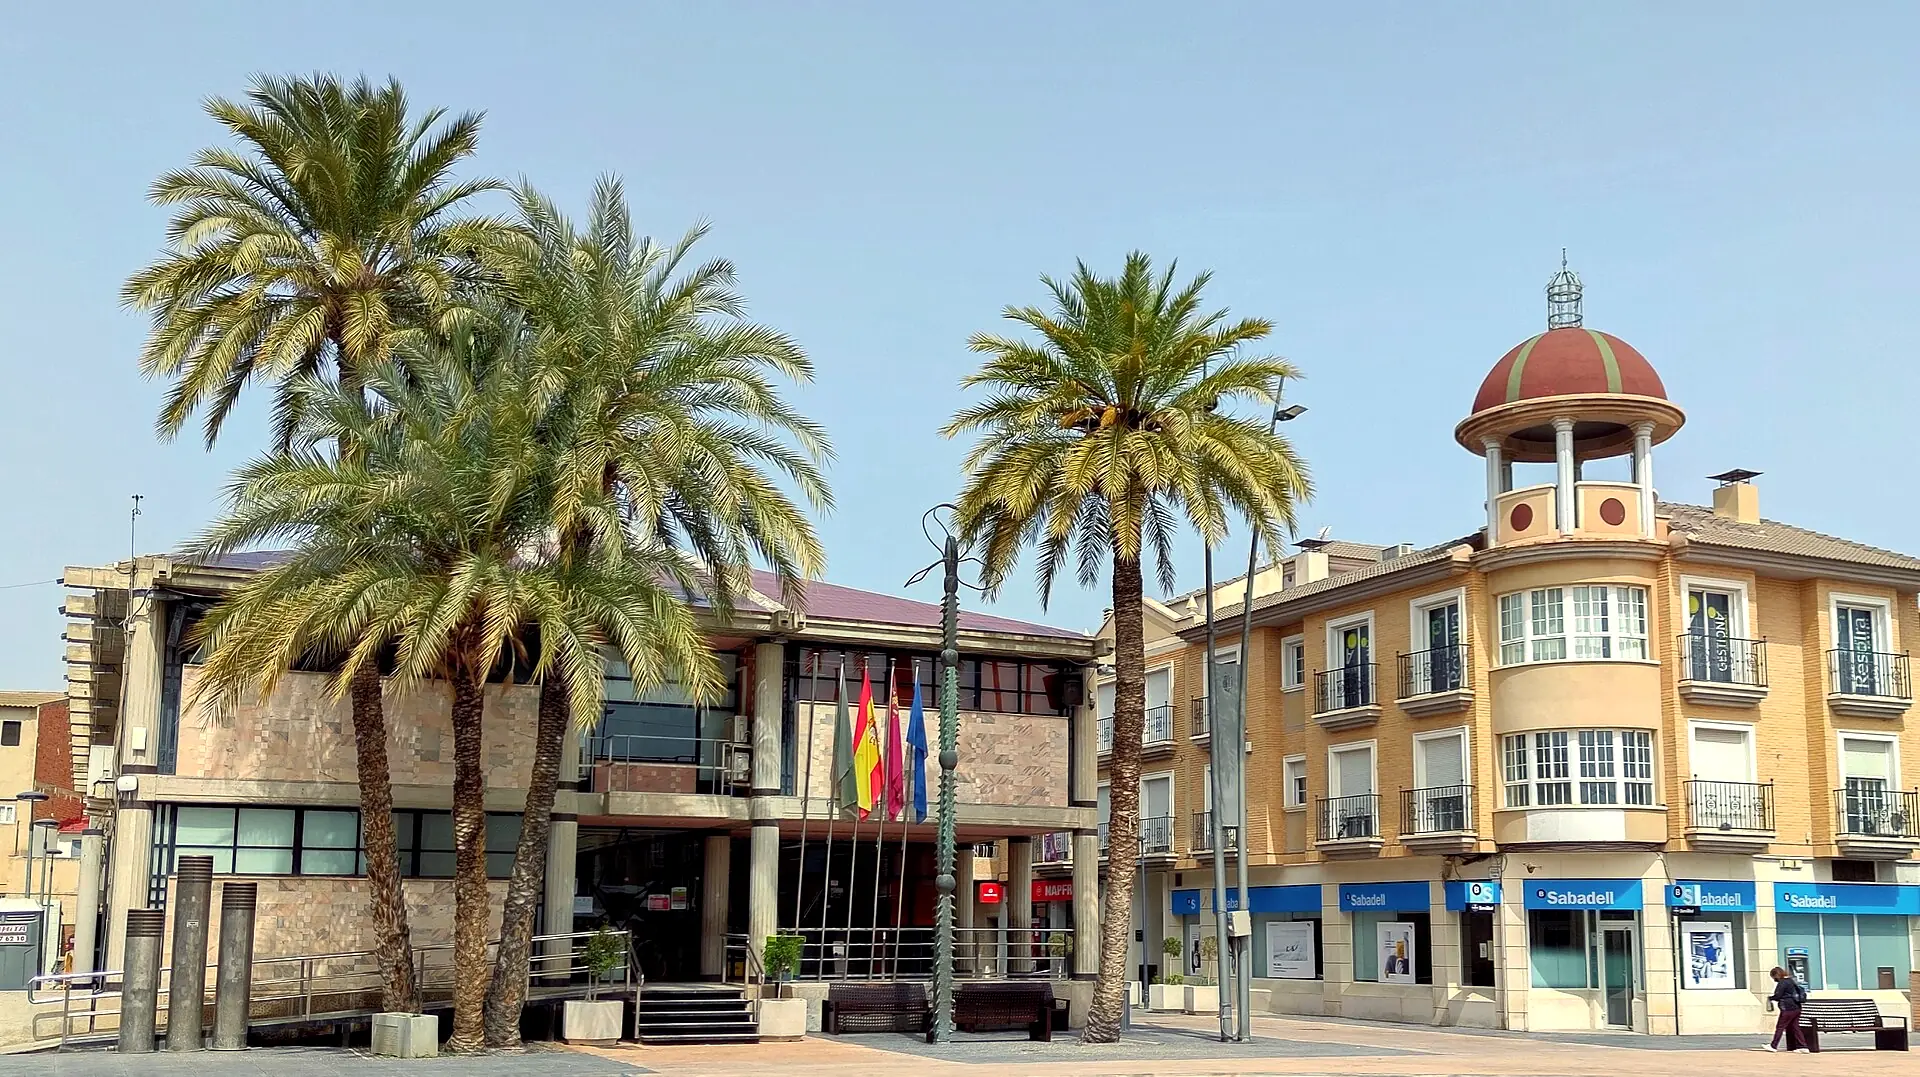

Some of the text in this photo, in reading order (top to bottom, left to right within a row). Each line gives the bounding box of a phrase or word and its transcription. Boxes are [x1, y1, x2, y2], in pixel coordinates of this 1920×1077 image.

[1045, 884, 1072, 897] MAPFR
[1350, 893, 1386, 906] Sabadell
[1547, 891, 1615, 905] Sabadell
[1790, 895, 1837, 908] Sabadell
